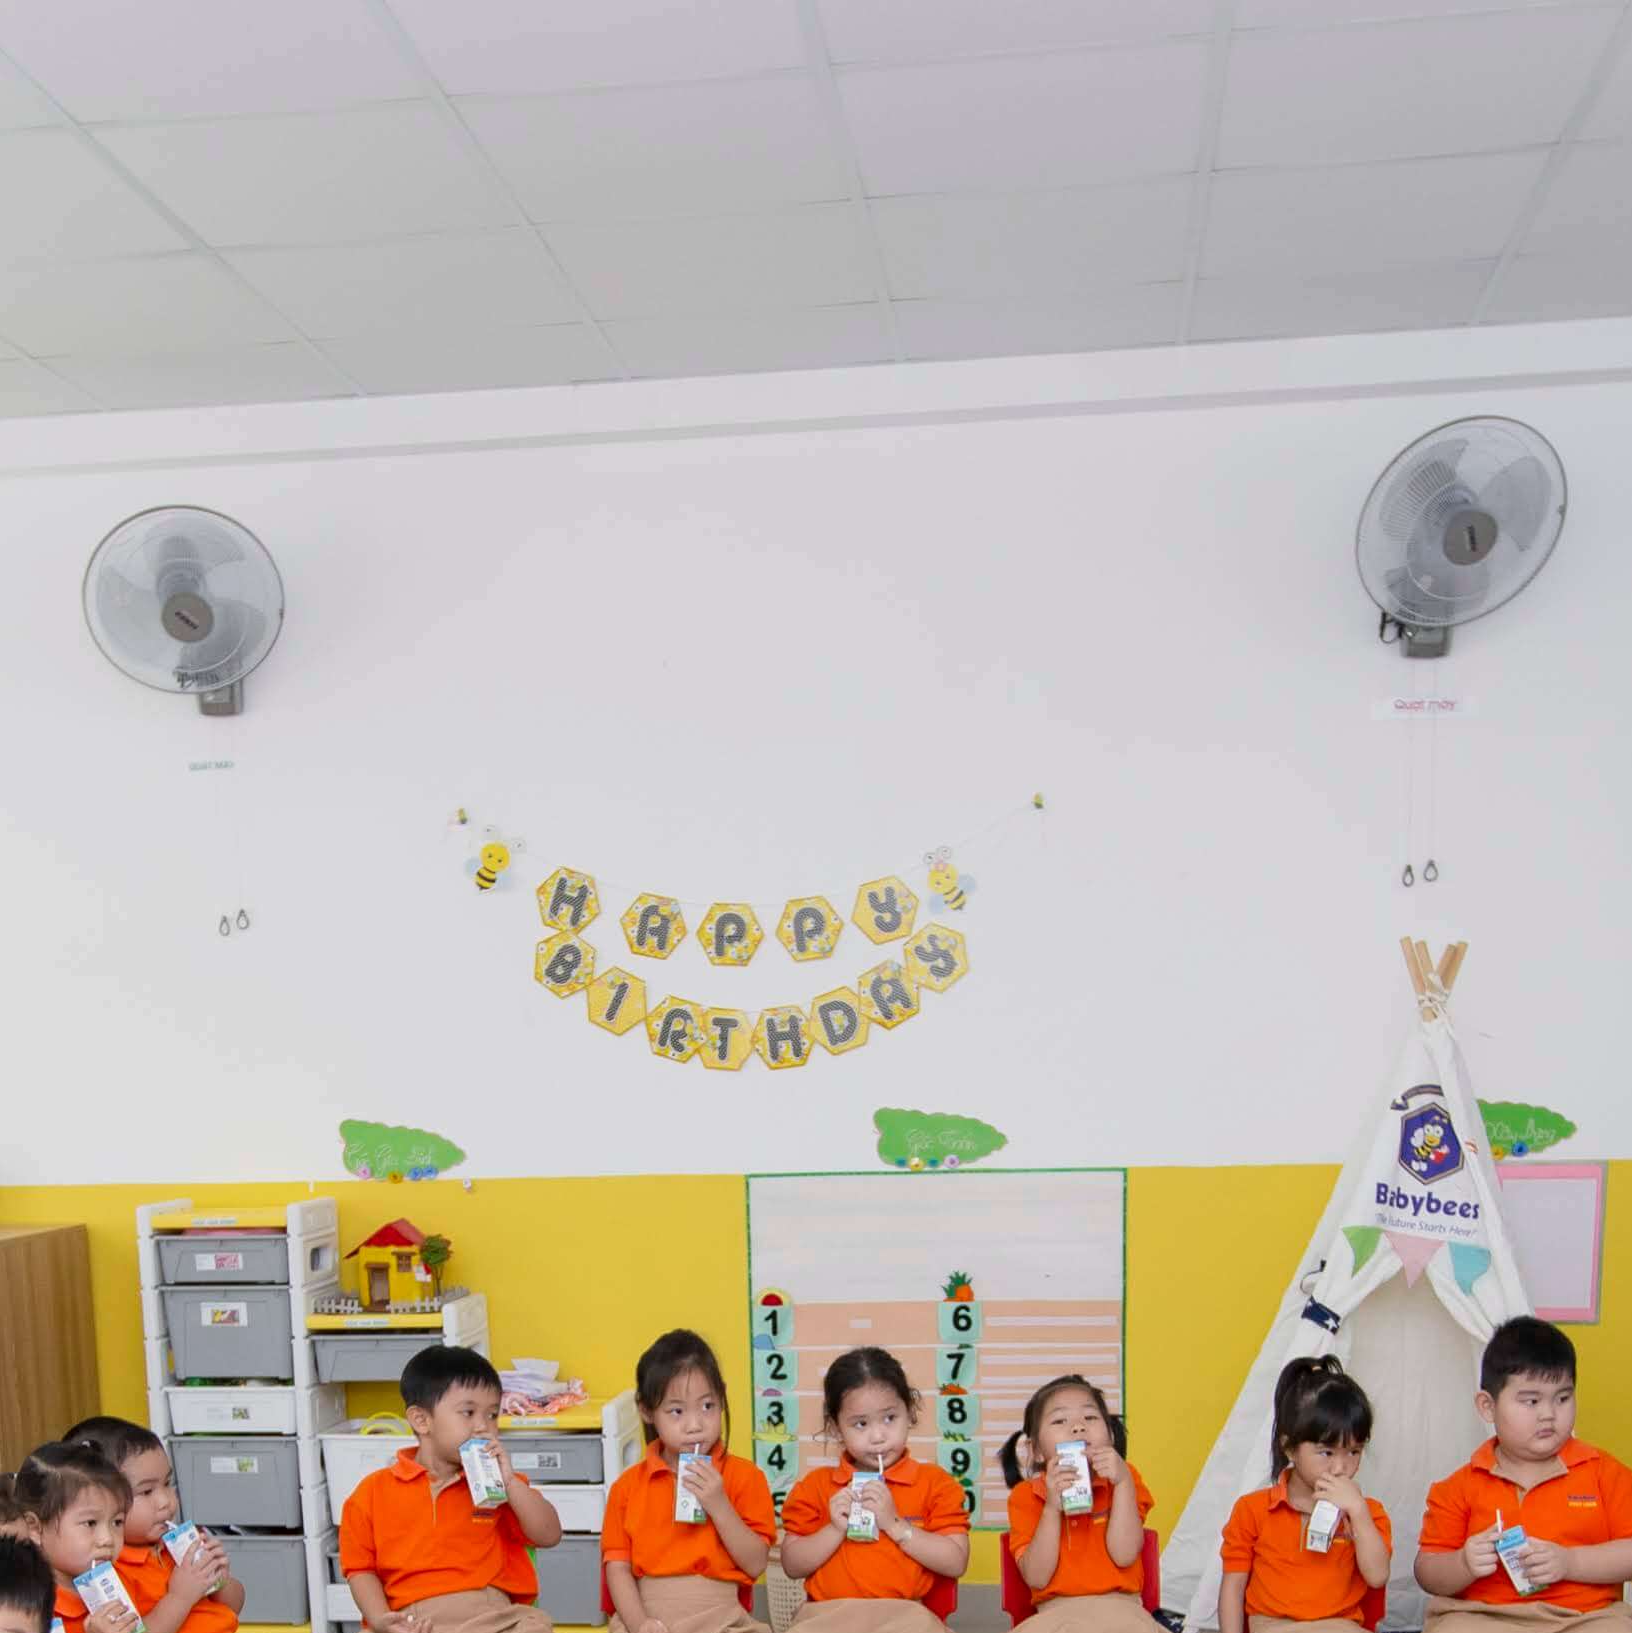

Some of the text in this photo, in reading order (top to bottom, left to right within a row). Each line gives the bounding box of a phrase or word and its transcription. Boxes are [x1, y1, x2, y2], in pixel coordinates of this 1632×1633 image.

[547, 874, 905, 959] HAPPY
[543, 933, 959, 1062] BIRTHDAY
[763, 1309, 780, 1337] 1
[952, 1304, 972, 1332] 6
[767, 1353, 788, 1382] 2
[946, 1352, 966, 1380] 7
[767, 1400, 785, 1427] 3
[947, 1398, 968, 1425] 8
[767, 1444, 787, 1471] 4
[950, 1447, 971, 1475] 9
